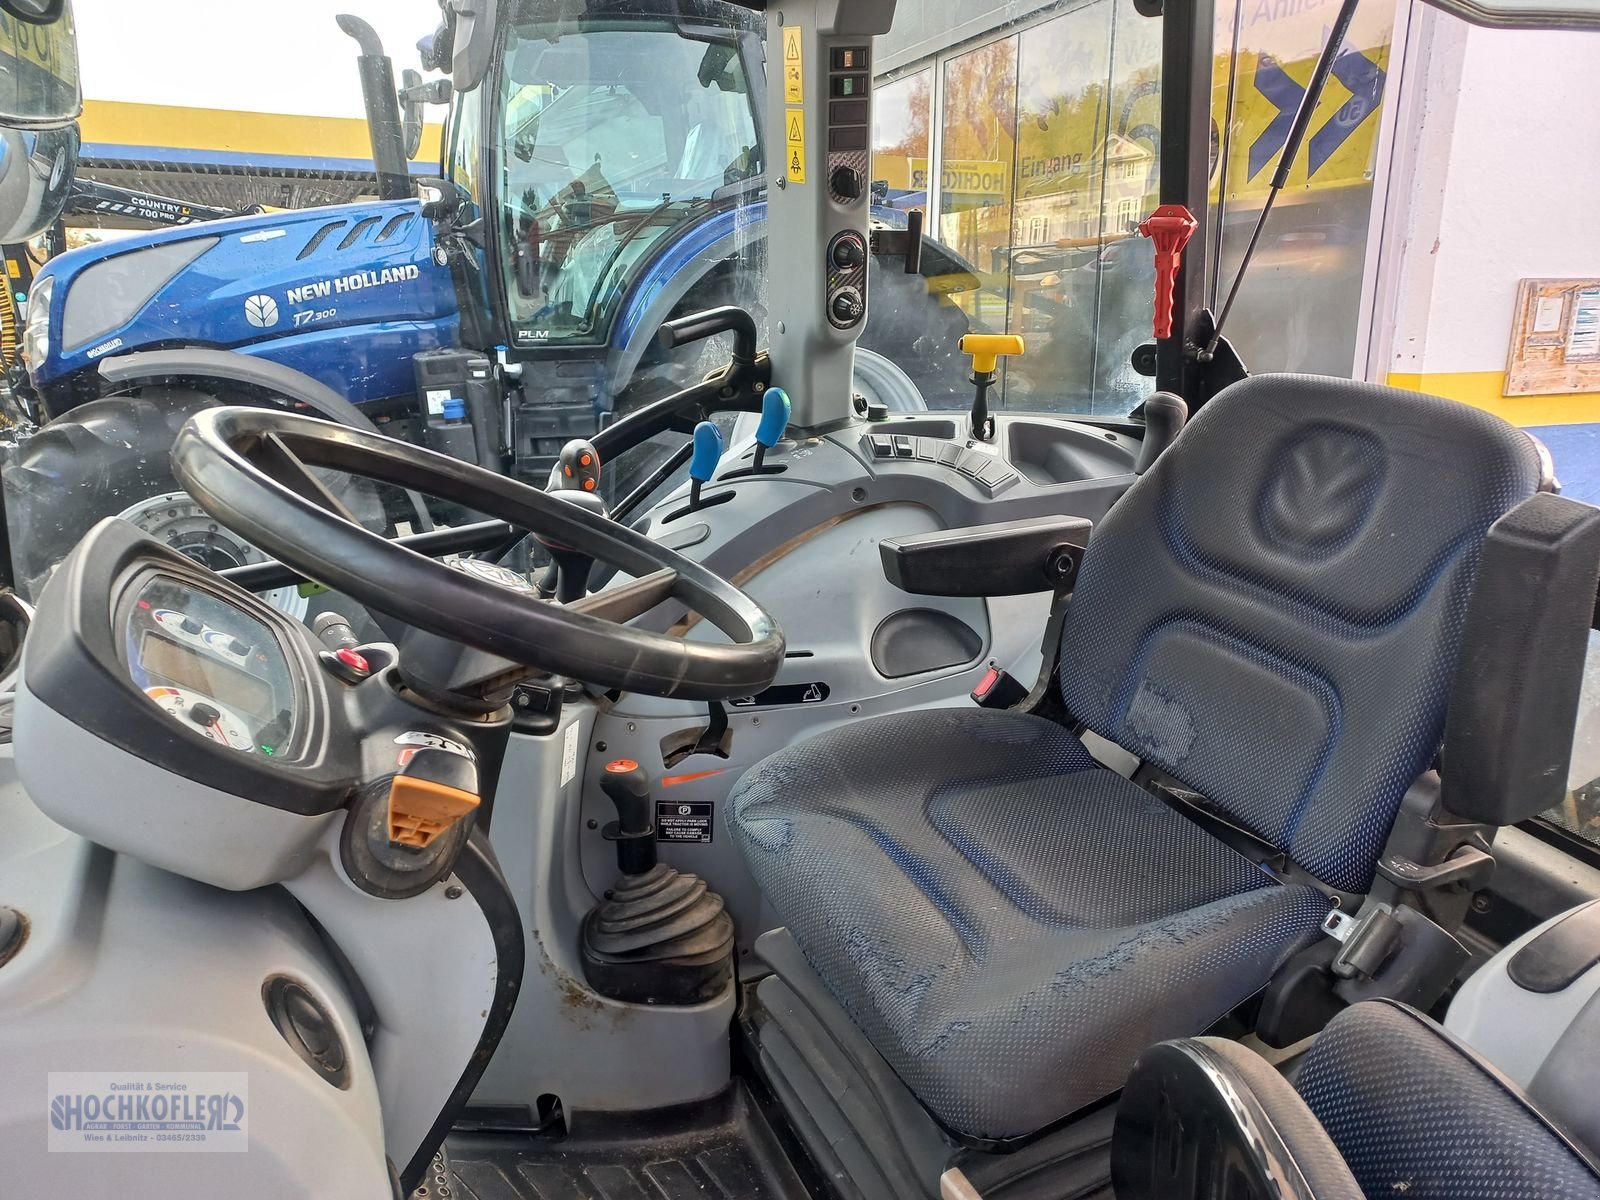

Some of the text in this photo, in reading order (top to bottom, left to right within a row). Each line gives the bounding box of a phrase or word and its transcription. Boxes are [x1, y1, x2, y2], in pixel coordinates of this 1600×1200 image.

[1021, 152, 1083, 179] Eingang
[131, 197, 180, 213] COUNTRY
[138, 207, 175, 220] 700 PRO
[286, 264, 419, 305] NEW HOLLAND
[293, 308, 337, 328] T7.300
[518, 330, 550, 339] PLM
